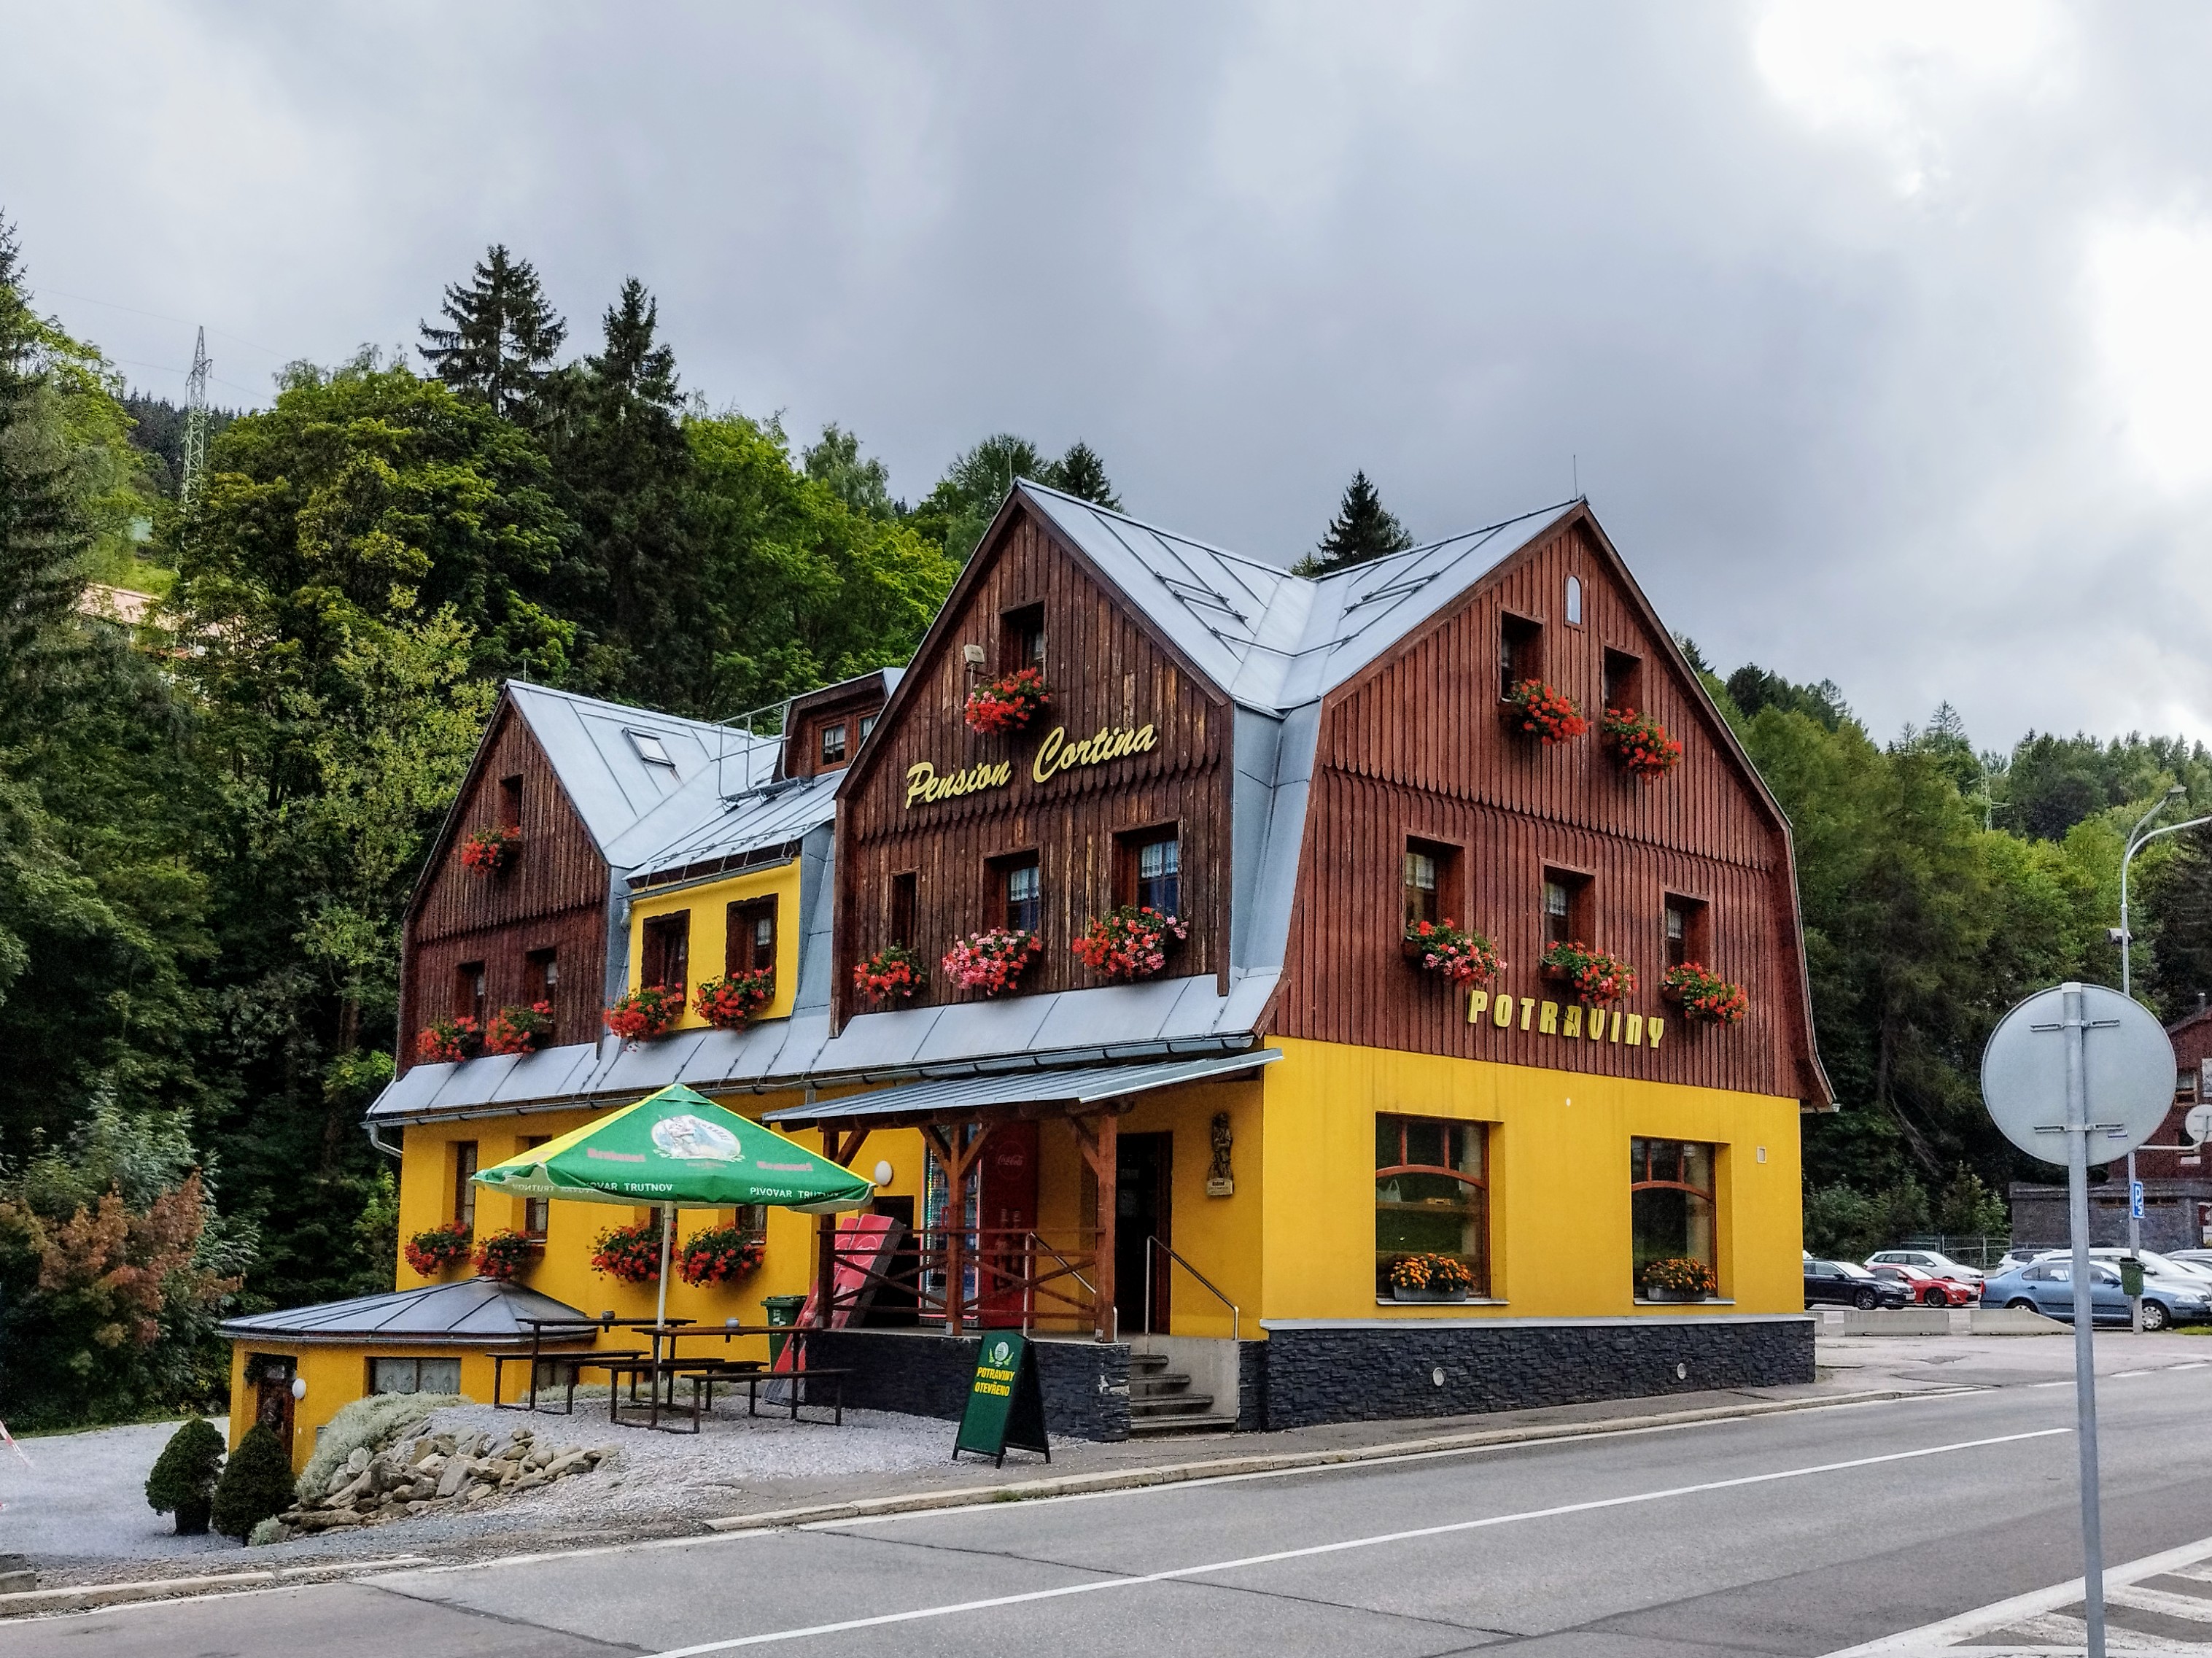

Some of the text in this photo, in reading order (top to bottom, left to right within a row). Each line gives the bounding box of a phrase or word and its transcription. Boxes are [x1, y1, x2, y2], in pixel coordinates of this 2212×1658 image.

[905, 724, 1158, 810] Pension Cortina
[1467, 989, 1665, 1049] POTRAVINY
[624, 1182, 674, 1193] TRUTNOV
[750, 1186, 793, 1198] PIVOVAR
[977, 1366, 1016, 1382] POTRAVINY
[974, 1381, 1011, 1397] OTEVŘENO
